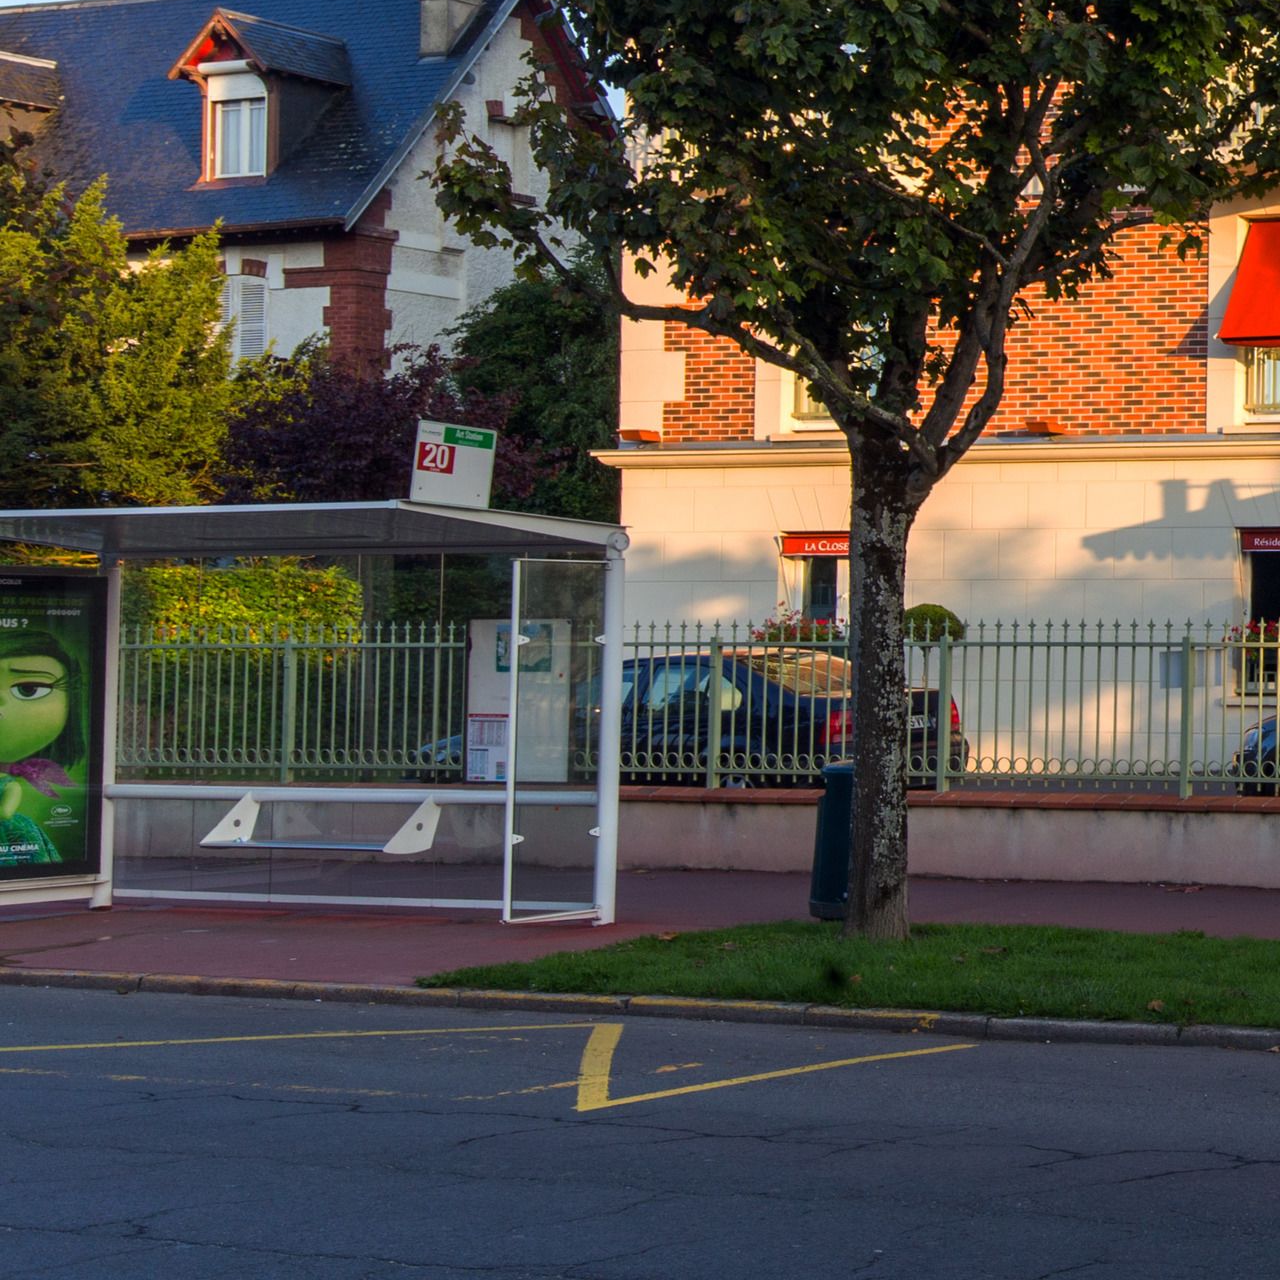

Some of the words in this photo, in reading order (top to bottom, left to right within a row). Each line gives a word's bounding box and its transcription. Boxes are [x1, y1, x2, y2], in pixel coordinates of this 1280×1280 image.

[422, 443, 450, 469] 20
[804, 542, 816, 551] LA
[818, 540, 850, 551] CLOSE
